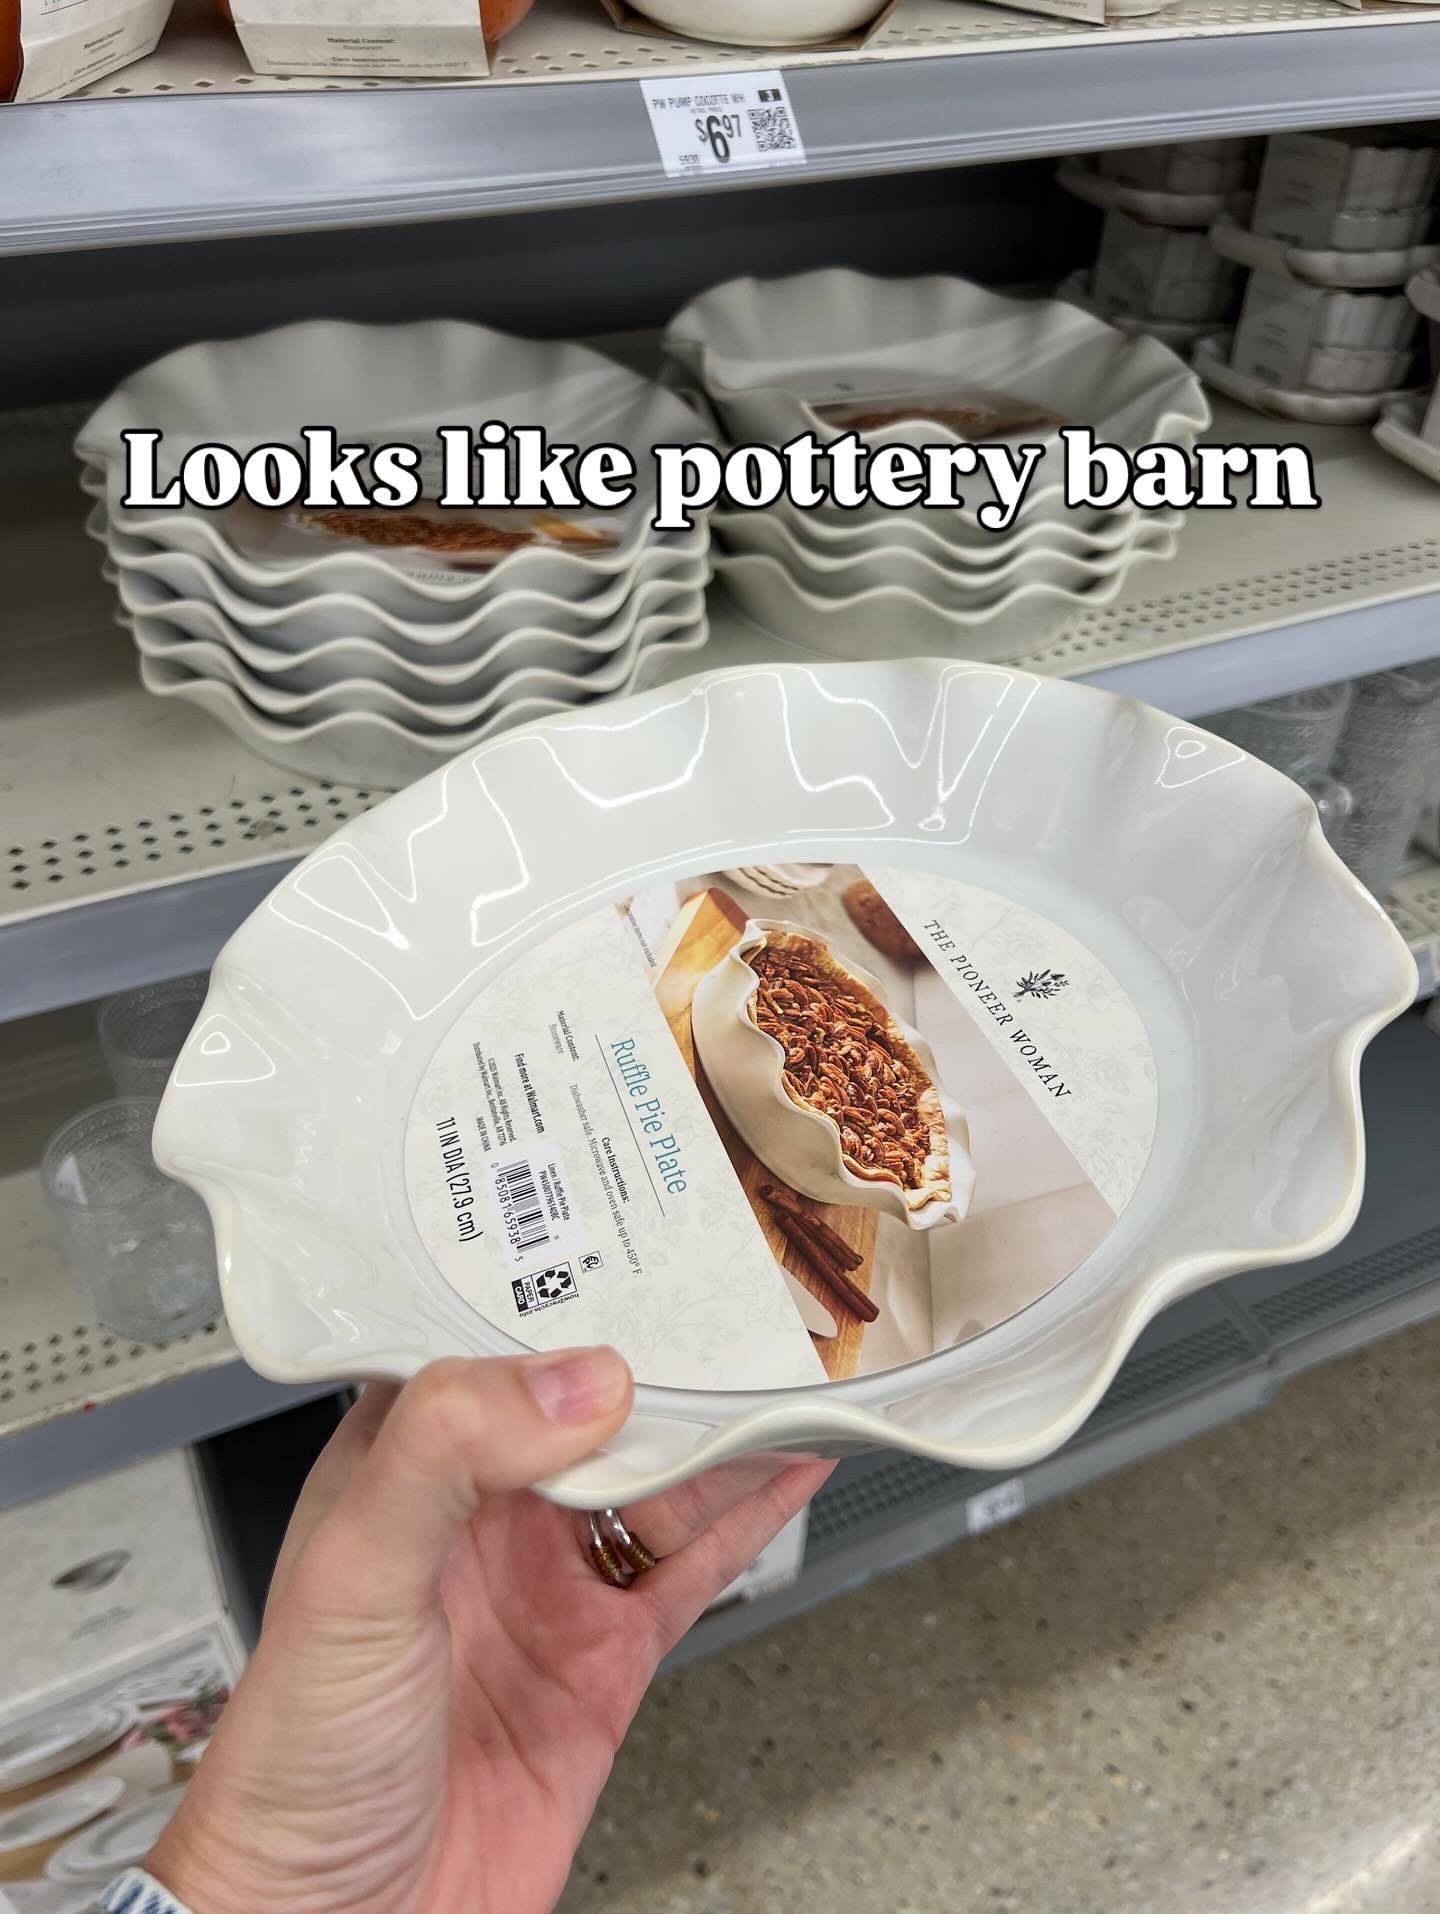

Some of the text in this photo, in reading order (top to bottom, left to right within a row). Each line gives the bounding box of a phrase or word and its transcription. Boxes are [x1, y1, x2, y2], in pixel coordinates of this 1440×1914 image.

[923, 919, 1073, 1099] THE PIONEER WOMAN
[557, 1010, 572, 1037] Material
[514, 1053, 545, 1134] Find more at Walmart.com
[569, 1084, 588, 1121] Dishwasher
[611, 1037, 687, 1195] Ruffle Pie Plate
[476, 1116, 492, 1152] MADE IN CHINA
[588, 1137, 607, 1176] Microwave
[436, 1116, 484, 1242] 11 IN DIA (27.9 cm)
[548, 1163, 557, 1178] Linen
[601, 1136, 631, 1204] Care Instructions:
[553, 1180, 564, 1197] Ruffle
[600, 1174, 612, 1191] and
[558, 1196, 567, 1206] Pie
[606, 1190, 618, 1210] oven
[560, 1205, 570, 1221] Plate
[613, 1208, 625, 1227] safe
[618, 1227, 629, 1241] up
[622, 1238, 632, 1248] to
[514, 1286, 524, 1305] CARD
[524, 1281, 534, 1303] PAPER
